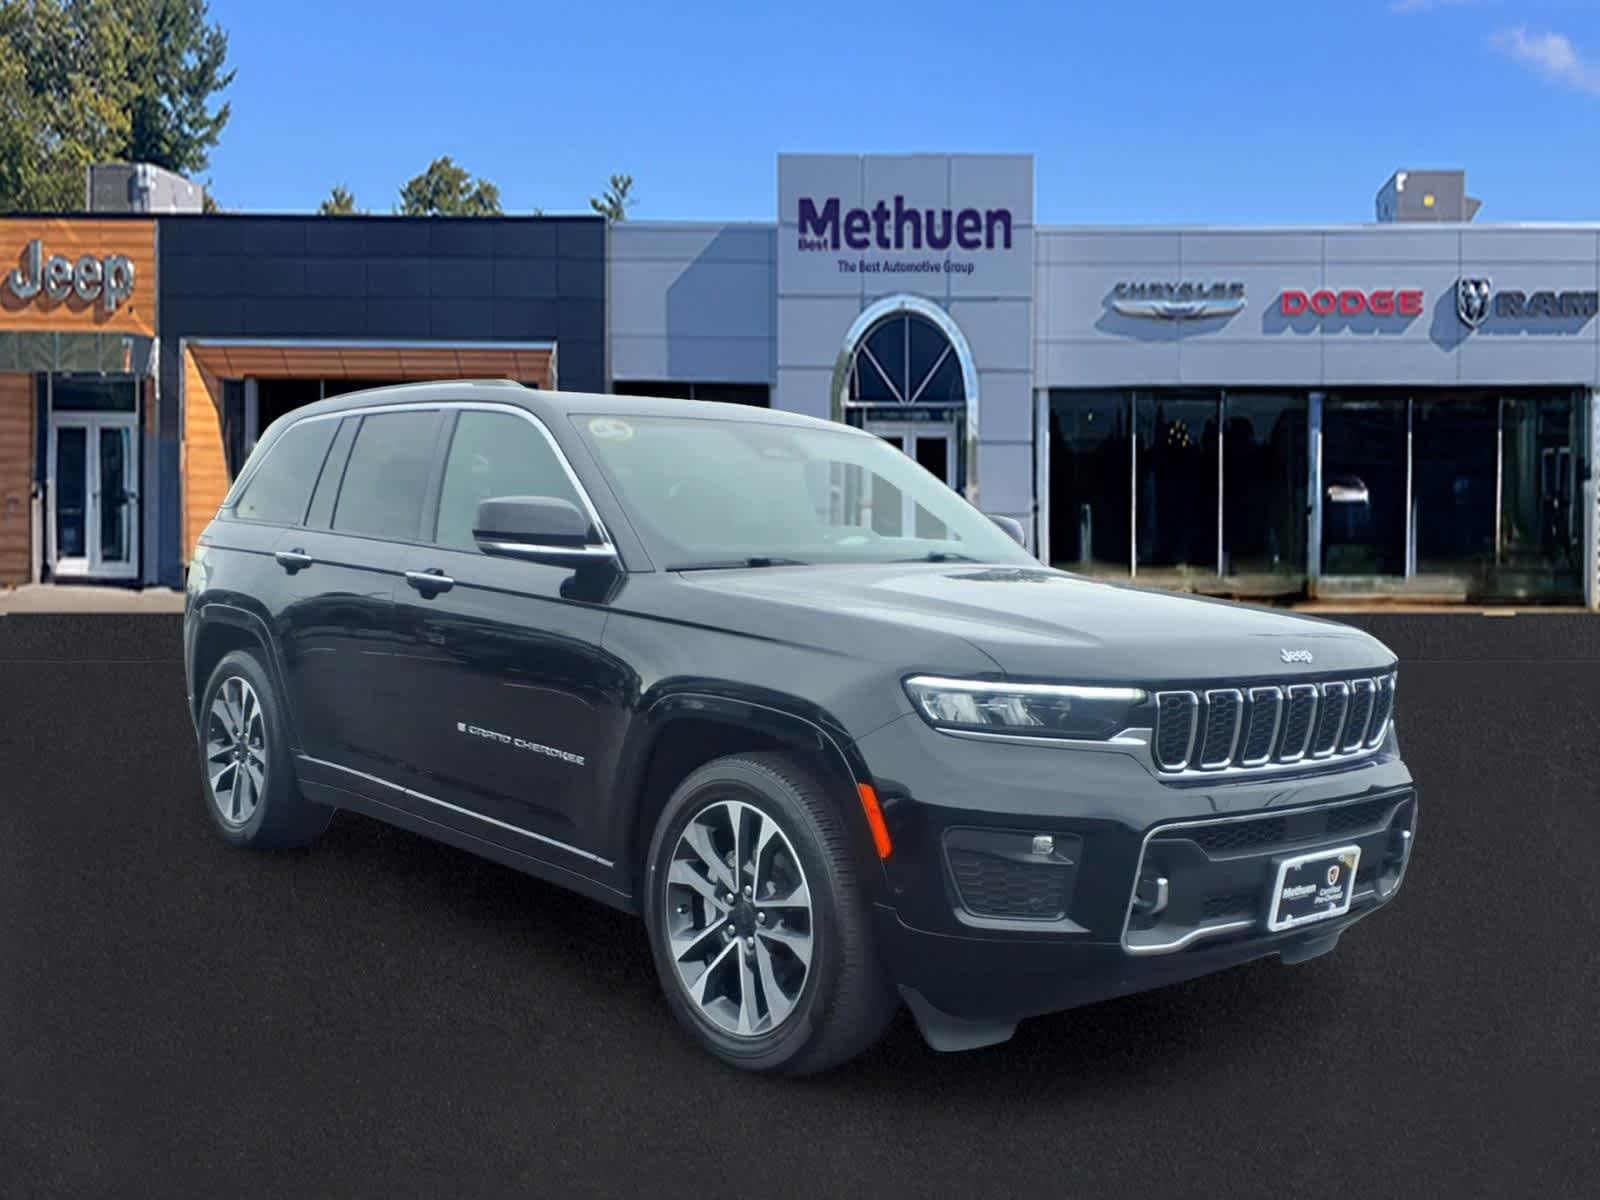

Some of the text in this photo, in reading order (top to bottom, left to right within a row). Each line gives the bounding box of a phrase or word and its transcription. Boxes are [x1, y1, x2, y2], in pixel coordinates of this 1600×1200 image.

[798, 195, 1012, 250] Methuen
[8, 239, 134, 312] Jeep
[838, 260, 974, 275] The Best Automotive Group
[1114, 282, 1244, 298] CHRYSLER
[1281, 290, 1424, 316] DODGE
[1496, 290, 1598, 317] RAM
[1280, 648, 1313, 664] Jeep
[468, 725, 585, 766] GRAND CHEROKEE
